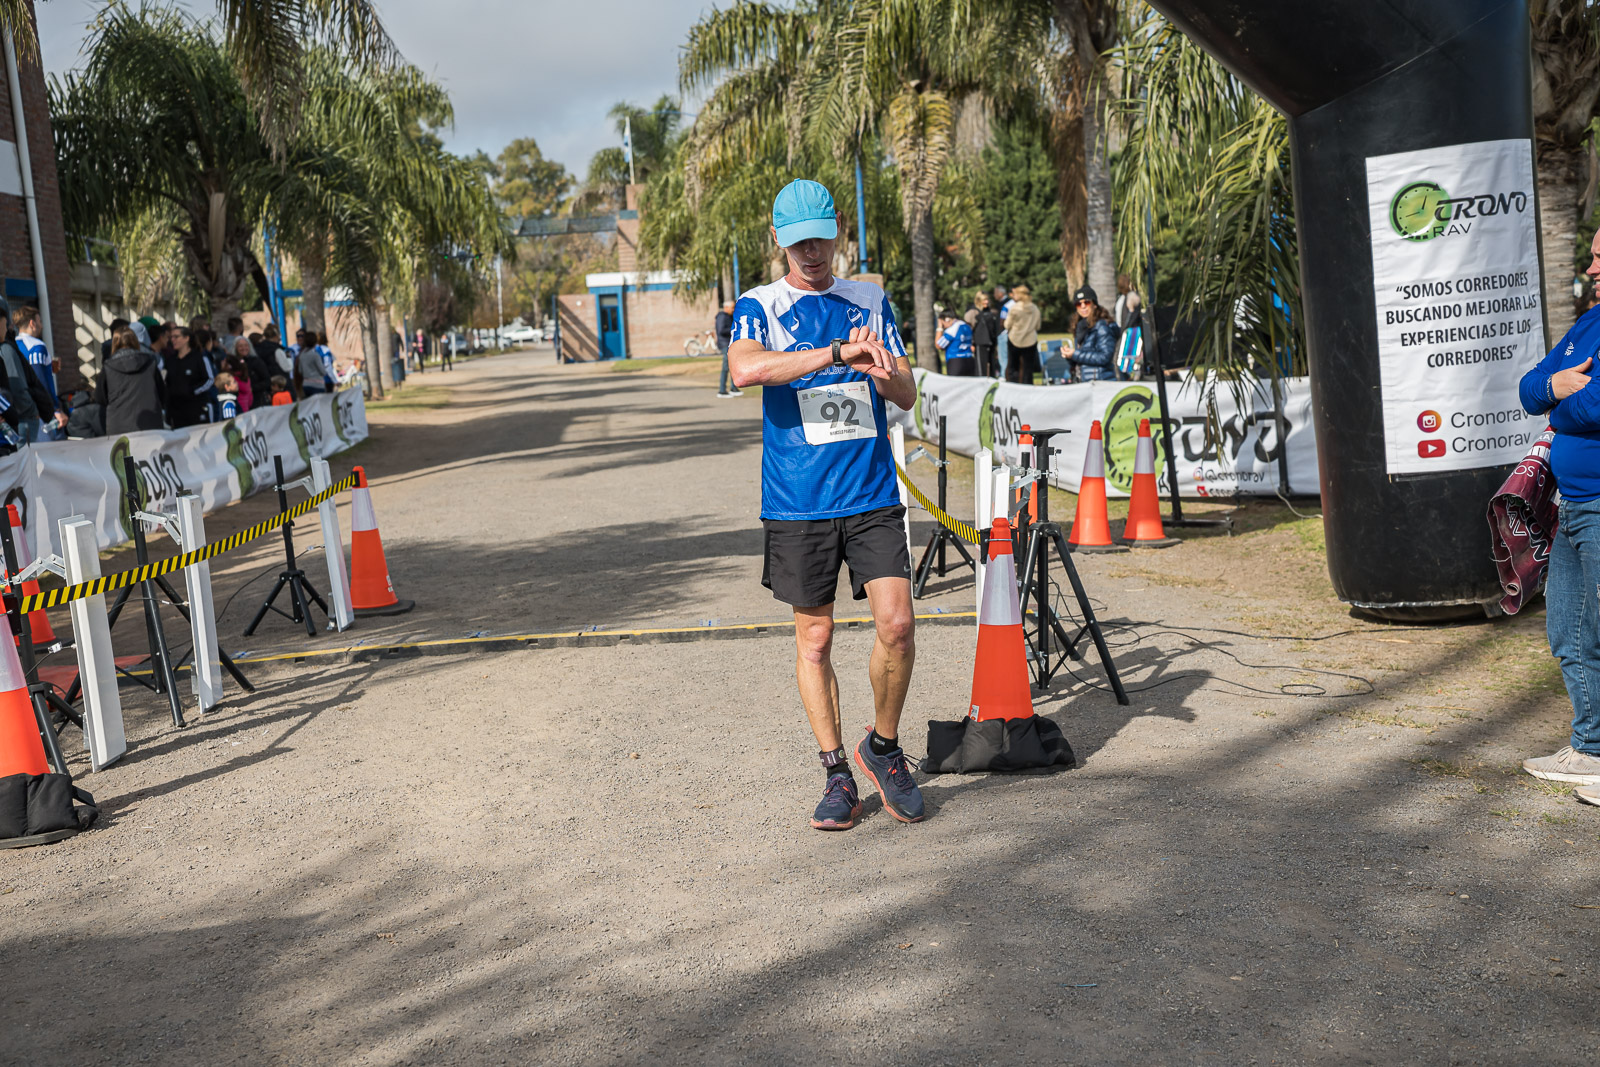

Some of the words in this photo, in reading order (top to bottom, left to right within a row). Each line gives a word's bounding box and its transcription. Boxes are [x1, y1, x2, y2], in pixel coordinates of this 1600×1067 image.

[1434, 191, 1527, 222] CRONO
[1433, 222, 1472, 238] RAV
[1396, 281, 1453, 300] “SOMOS
[1456, 271, 1528, 294] CORREDORES
[1386, 303, 1462, 325] BUSCANDO
[1466, 296, 1522, 317] MEJORAR
[1524, 294, 1537, 309] LAS
[1401, 323, 1497, 347] EXPERIENCIAS
[1500, 321, 1514, 337] DE
[1517, 318, 1531, 335] LOS
[1427, 344, 1518, 368] CORREDORES”
[820, 399, 860, 429] 92
[1451, 408, 1529, 428] Cronorav
[1452, 432, 1531, 453] Cronorav
